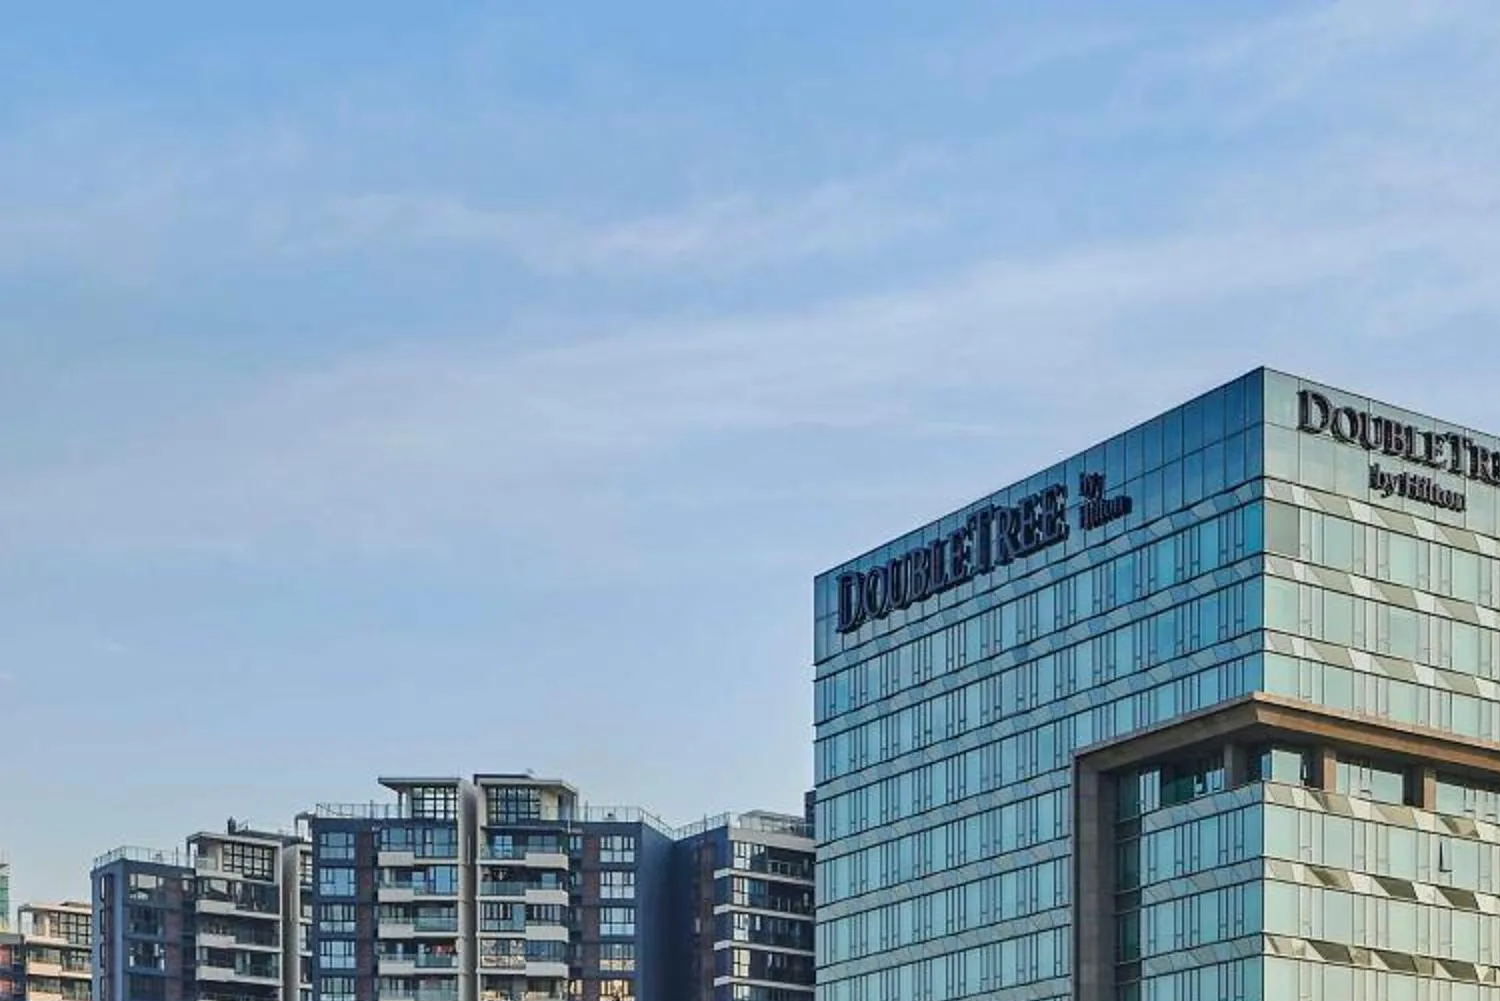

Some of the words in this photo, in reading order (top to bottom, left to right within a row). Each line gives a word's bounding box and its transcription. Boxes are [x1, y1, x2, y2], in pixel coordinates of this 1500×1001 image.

[1080, 472, 1106, 499] by
[1369, 463, 1400, 498] by
[1399, 471, 1466, 512] Hilton
[1080, 495, 1133, 530] Hilton
